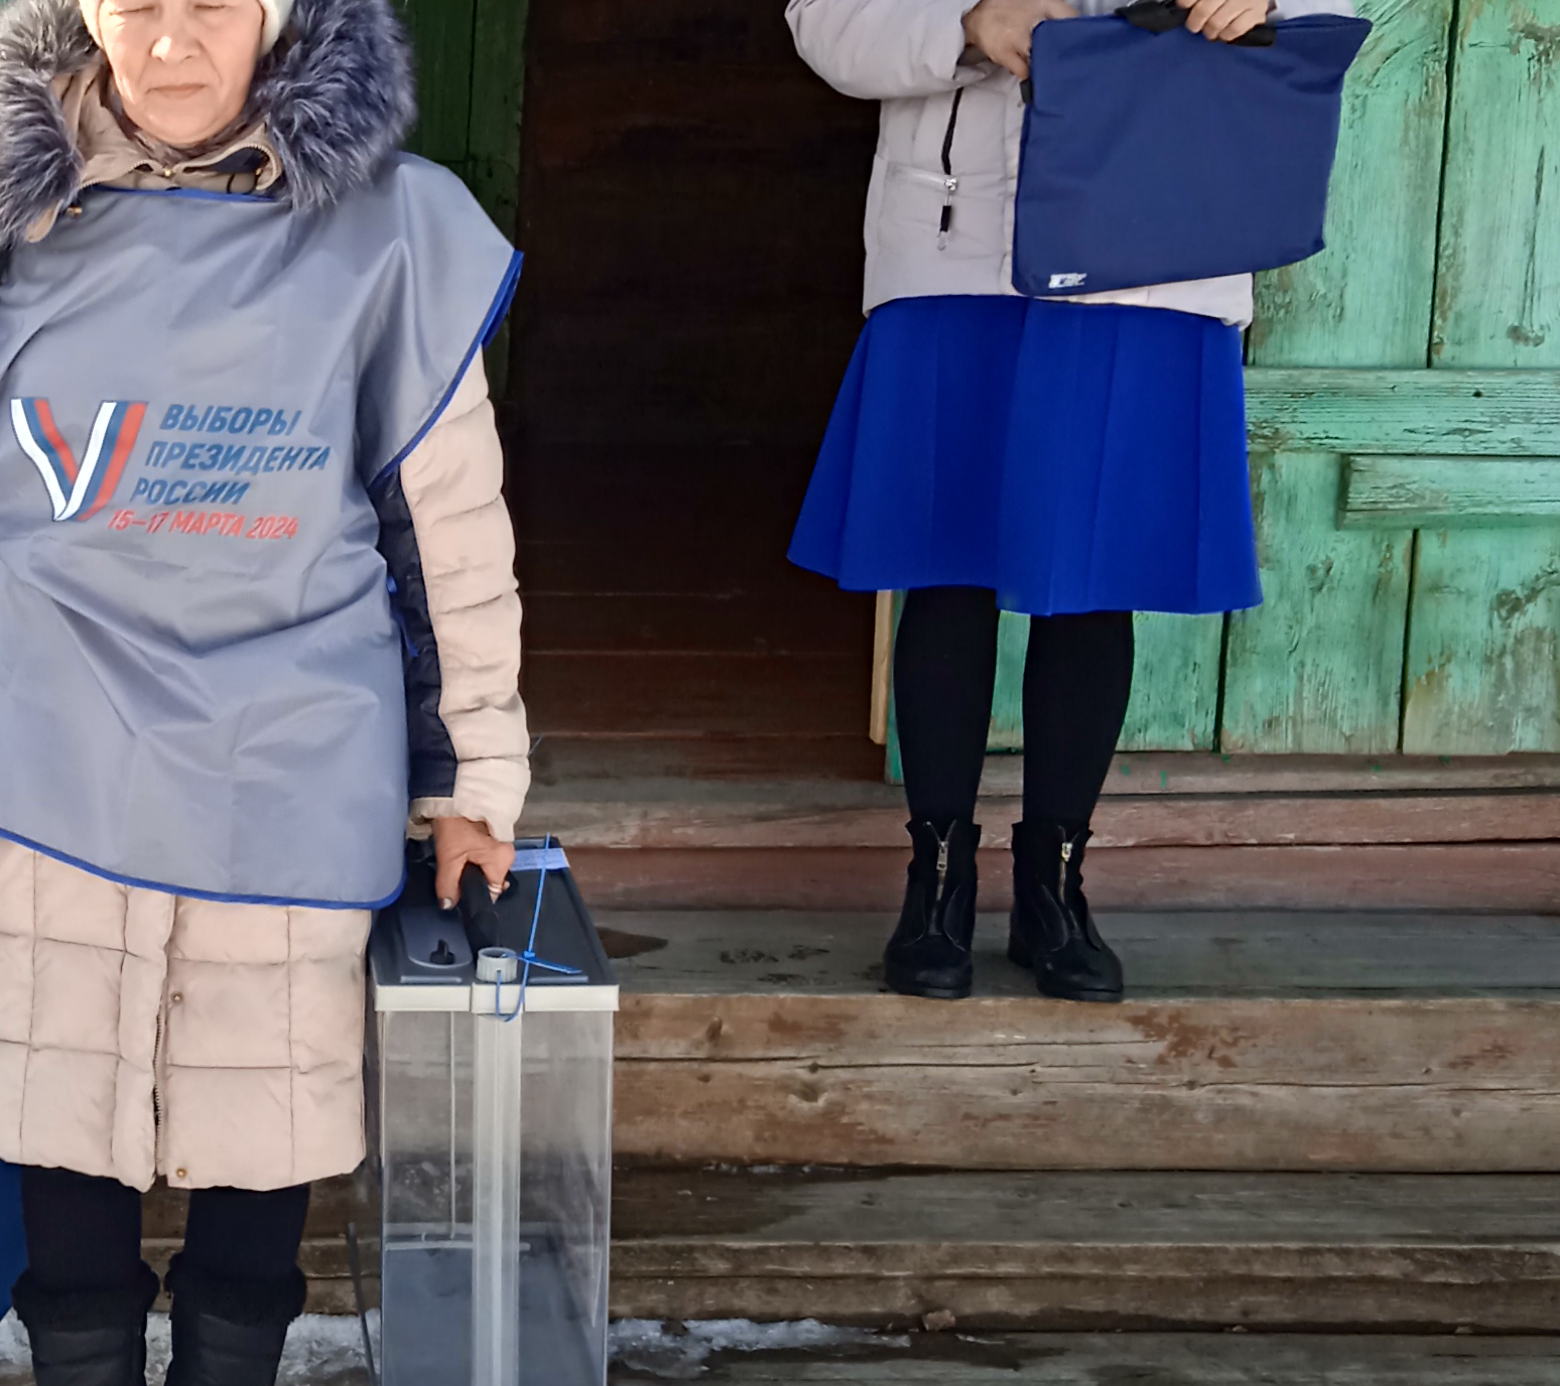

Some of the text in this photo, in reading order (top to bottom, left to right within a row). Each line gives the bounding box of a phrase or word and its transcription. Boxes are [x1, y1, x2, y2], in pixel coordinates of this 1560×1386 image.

[159, 403, 302, 436] ВЫБОРЫ
[144, 440, 332, 476] ПРЕЗИДЕНТА
[129, 477, 252, 507] РОССИИ
[107, 509, 300, 541] 15–17 МАРТА 2024
